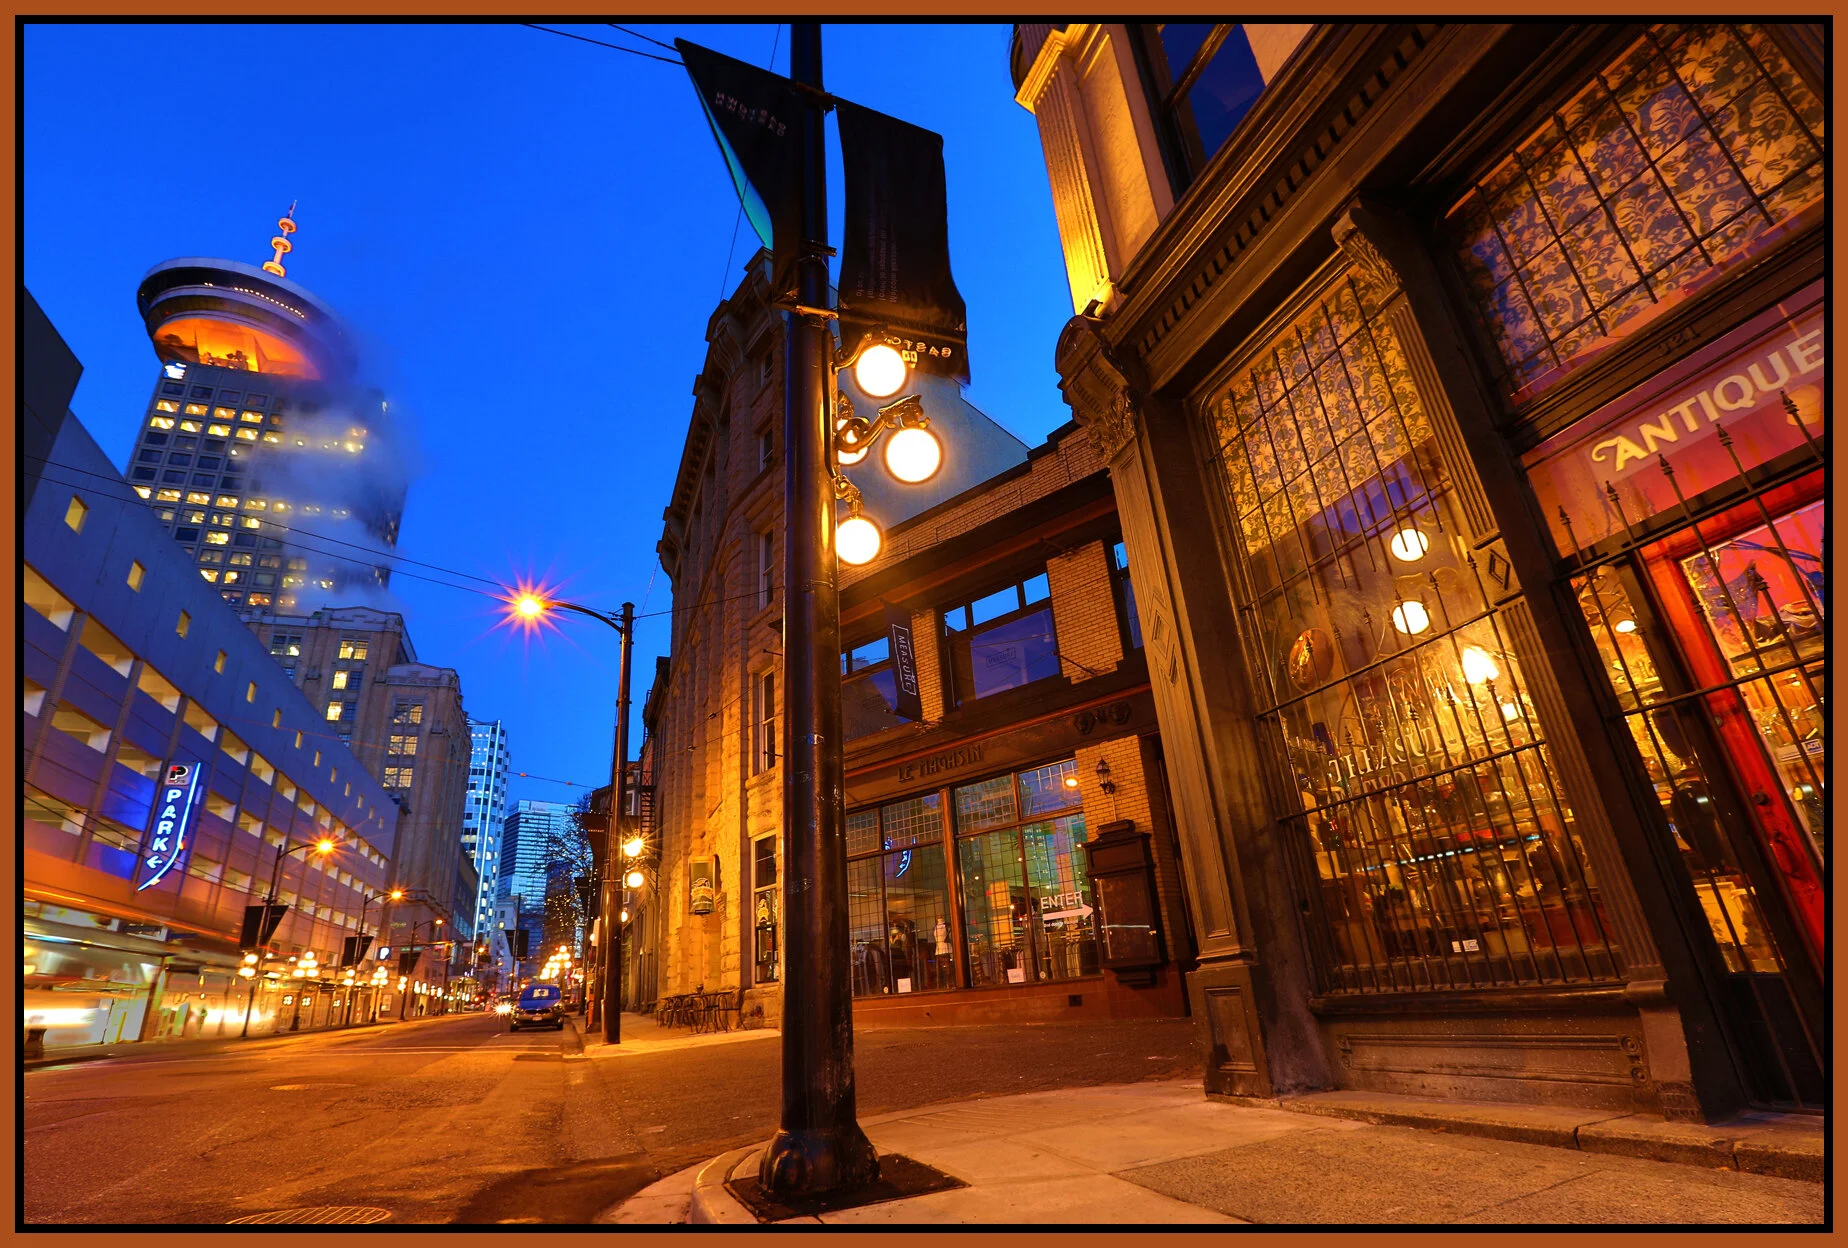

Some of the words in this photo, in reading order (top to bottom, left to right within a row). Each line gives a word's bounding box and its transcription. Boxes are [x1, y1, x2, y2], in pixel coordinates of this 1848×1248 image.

[1591, 328, 1824, 472] ANTIQUE
[898, 635, 912, 691] MEASURE
[898, 765, 915, 783] LE
[152, 789, 182, 851] PARK
[1040, 890, 1083, 909] ENTER
